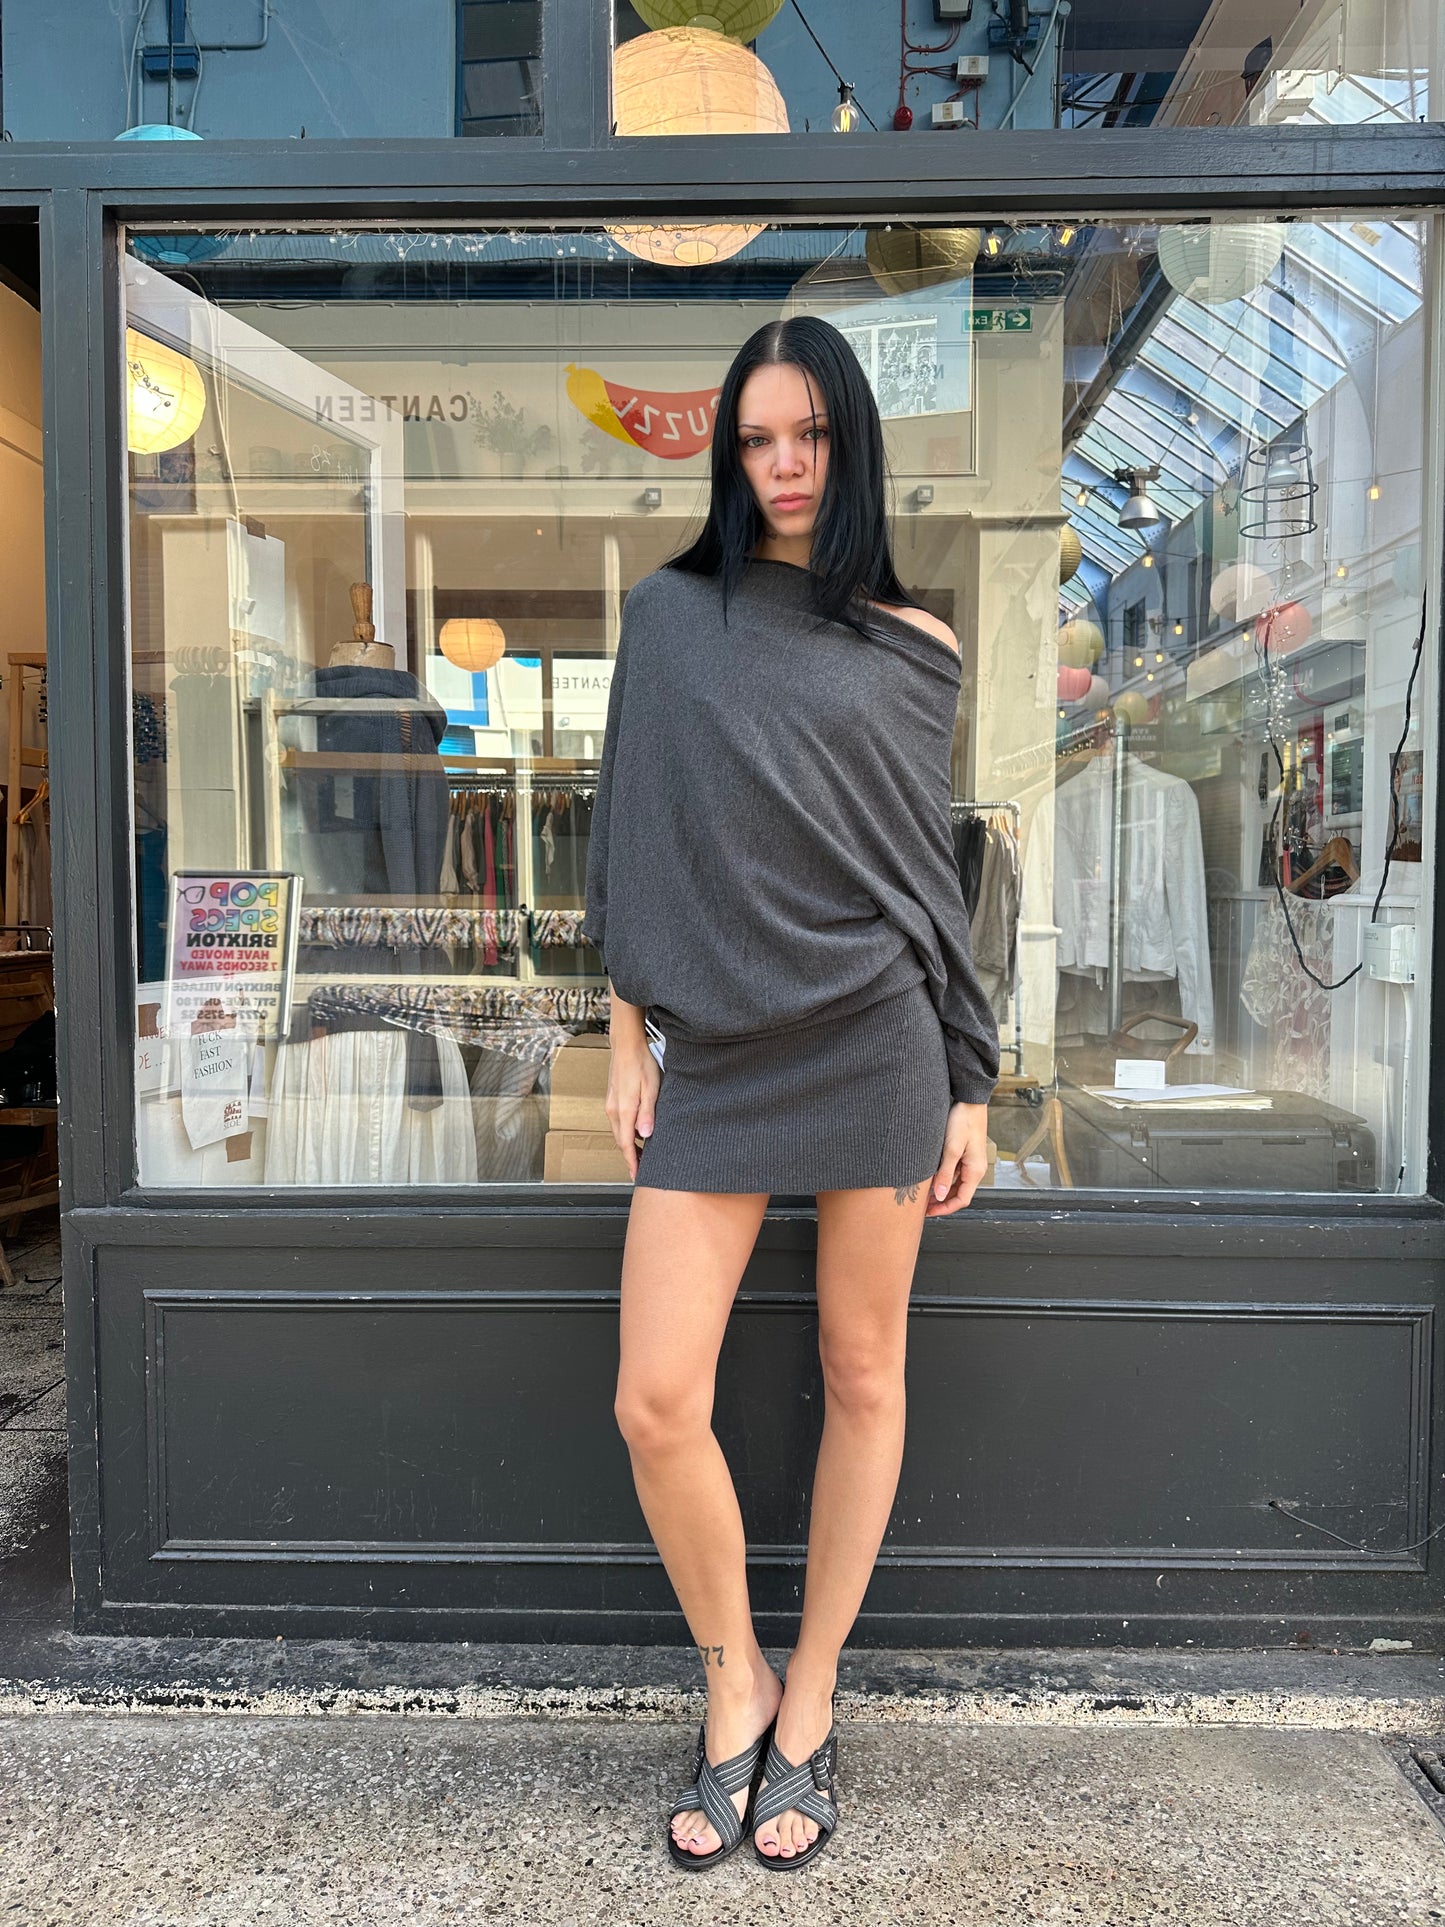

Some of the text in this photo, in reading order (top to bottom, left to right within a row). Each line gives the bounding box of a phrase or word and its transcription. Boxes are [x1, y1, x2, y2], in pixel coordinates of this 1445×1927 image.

[200, 1045, 222, 1061] FAST
[194, 1058, 233, 1080] FASHION
[700, 1645, 726, 1668] 77
